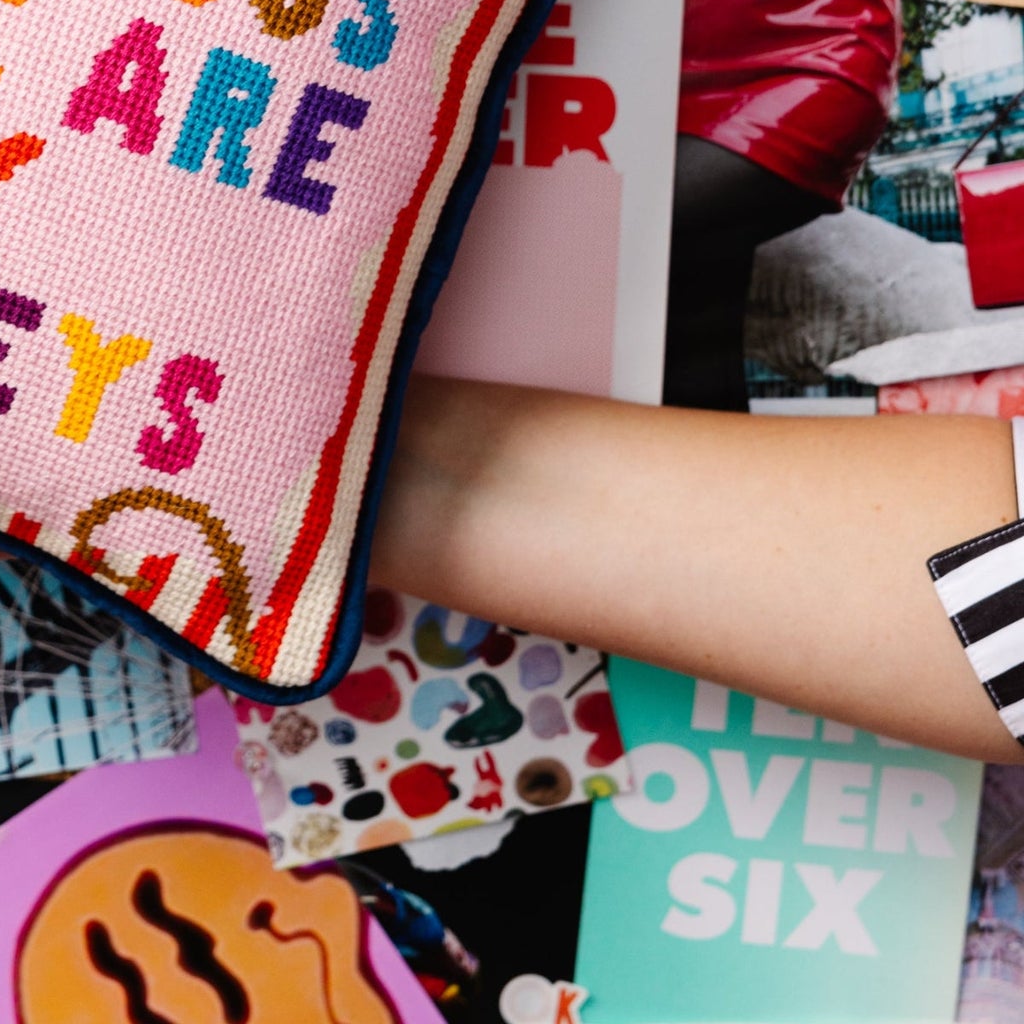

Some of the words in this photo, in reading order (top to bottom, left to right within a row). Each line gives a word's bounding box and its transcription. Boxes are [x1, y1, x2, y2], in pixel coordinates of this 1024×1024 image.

[61, 17, 370, 216] ARE
[612, 743, 959, 860] OVER
[660, 852, 885, 957] SIX
